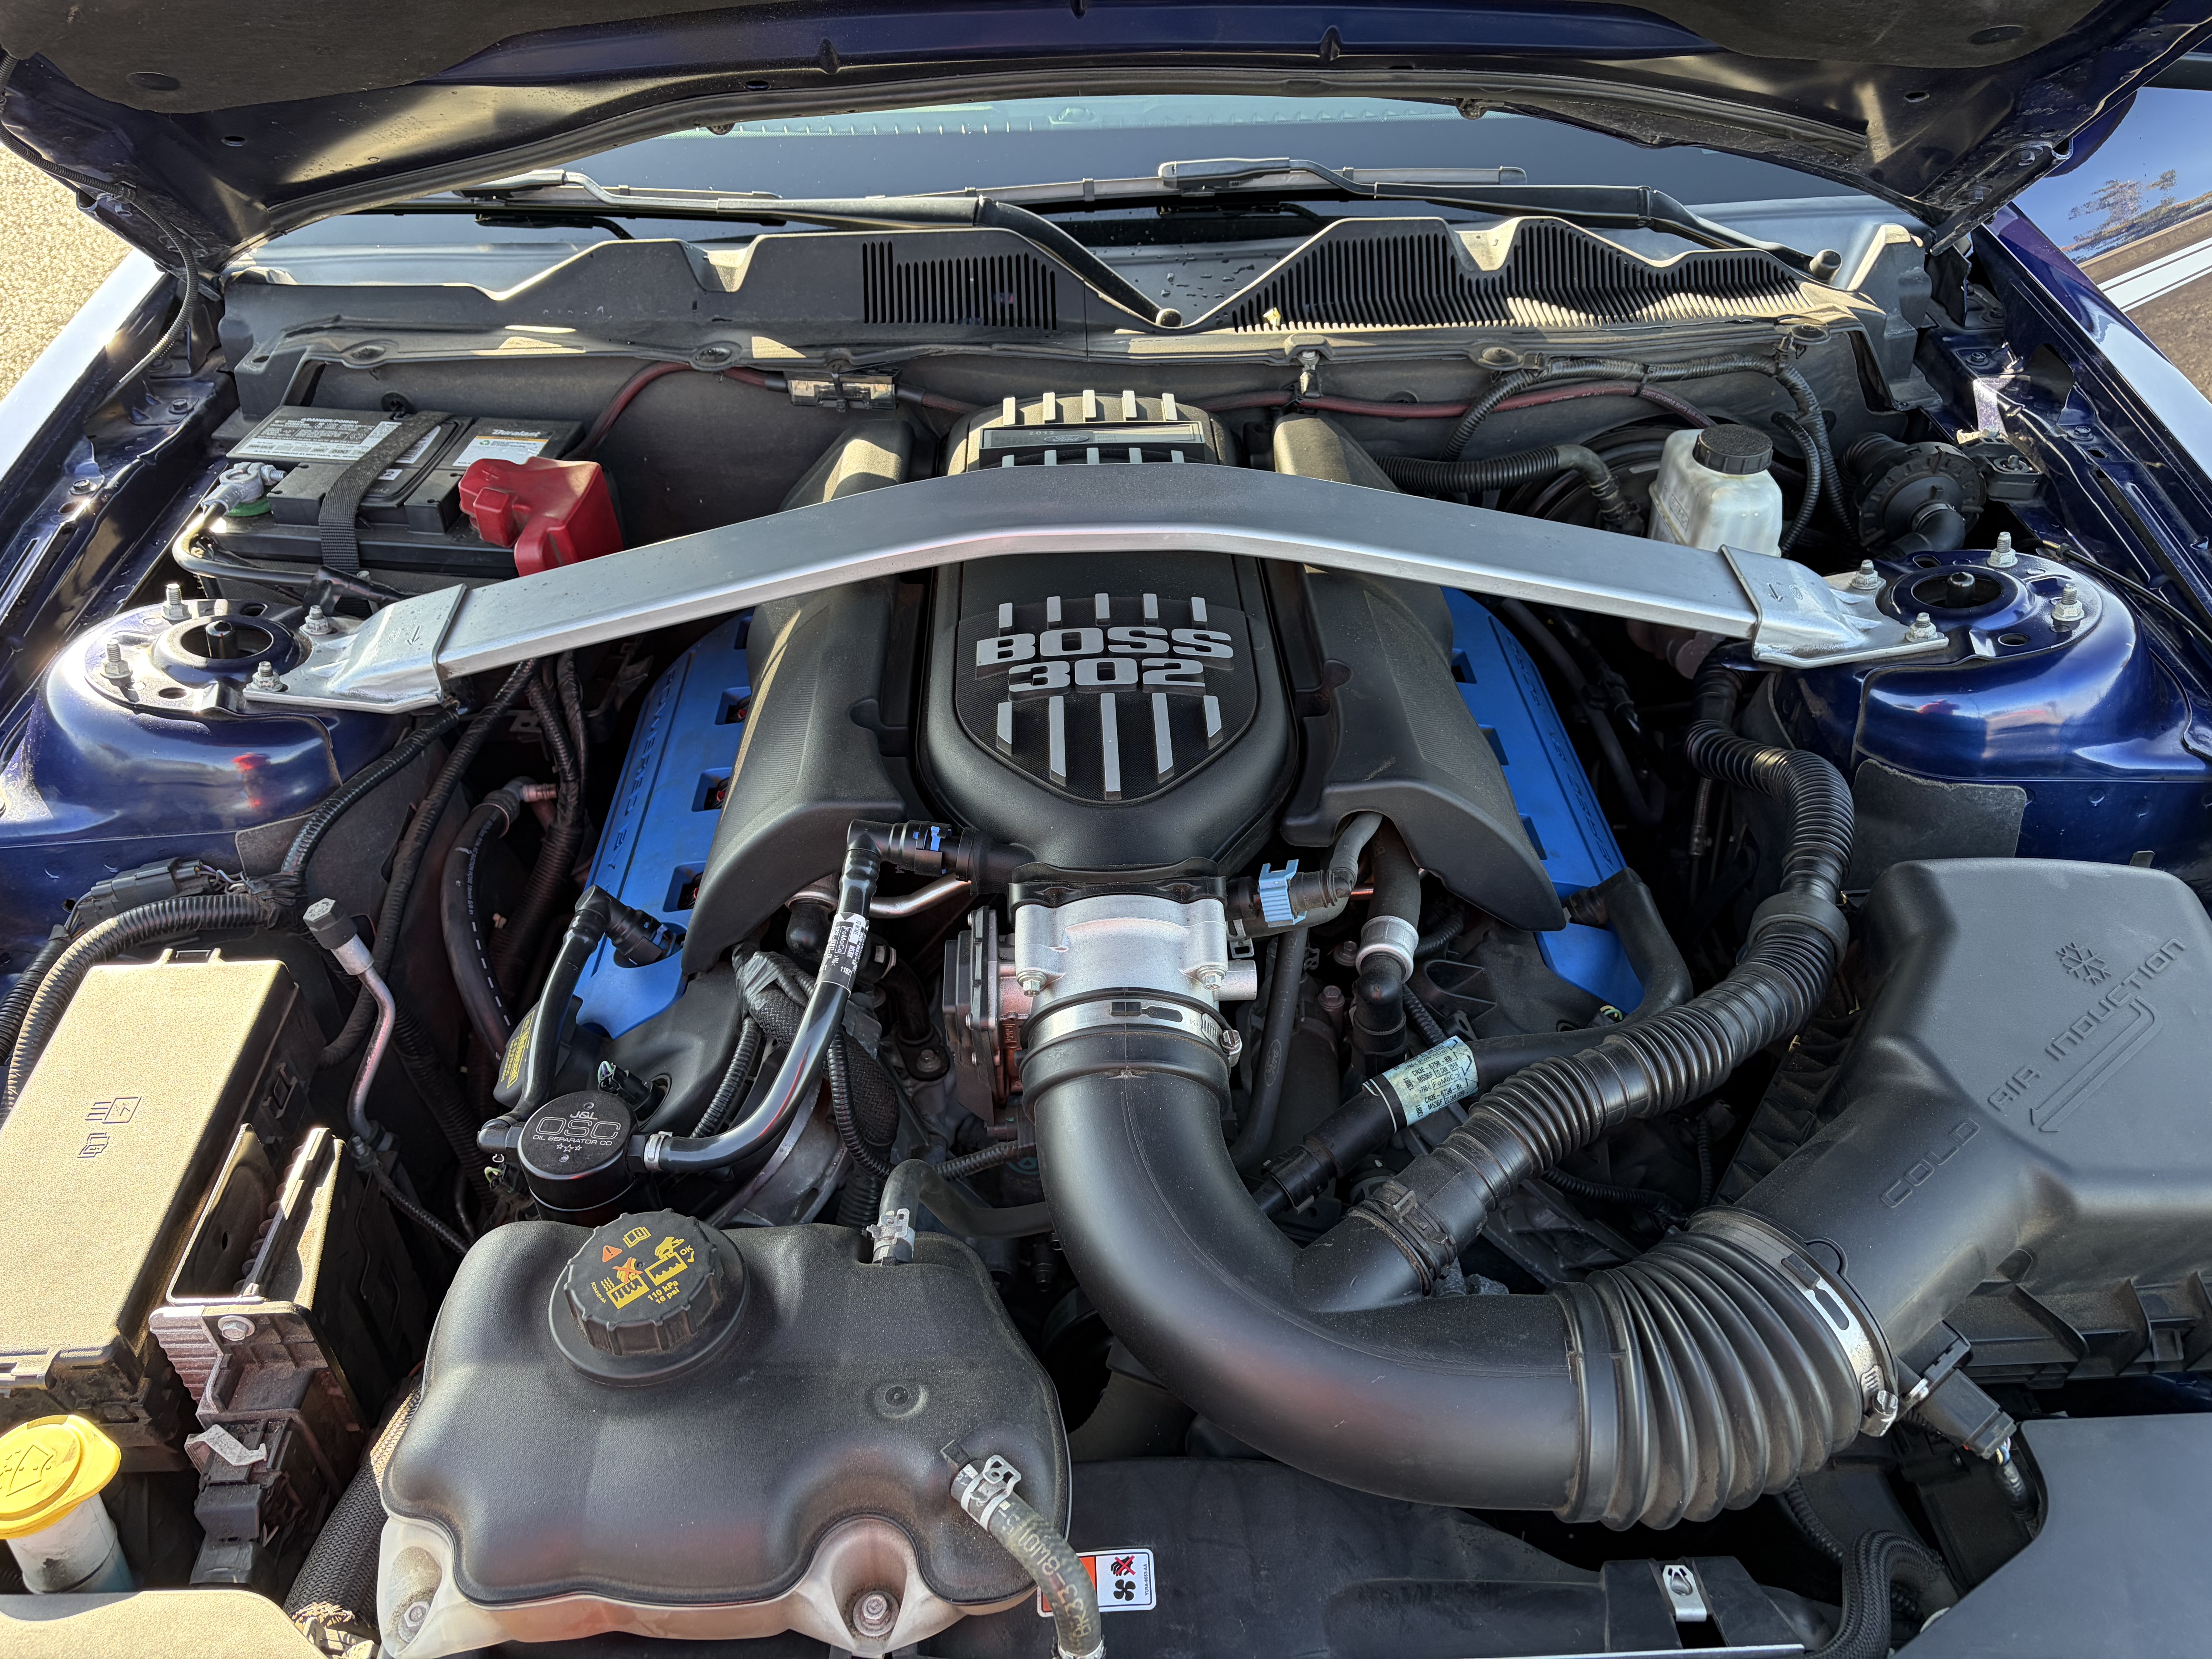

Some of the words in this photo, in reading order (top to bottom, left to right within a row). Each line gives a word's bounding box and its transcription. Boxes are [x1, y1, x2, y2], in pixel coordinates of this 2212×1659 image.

[975, 626, 1234, 670] BOSS
[1008, 658, 1206, 695] 302
[624, 665, 678, 817] POWERED
[837, 927, 848, 953] FoMoCo
[1412, 1056, 1452, 1076] CR3E-6758-BB
[1880, 1116, 1981, 1208] COLD
[1987, 1064, 2043, 1112] AIR
[2045, 938, 2186, 1061] INDUCTION
[570, 1110, 599, 1121] J&L
[534, 1116, 622, 1139] OSC
[548, 1135, 598, 1146] SEPARATOR
[679, 1244, 694, 1256] OK
[647, 1288, 663, 1302] 110
[662, 1280, 680, 1295] kPa
[655, 1294, 666, 1305] 16
[666, 1287, 680, 1301] psi
